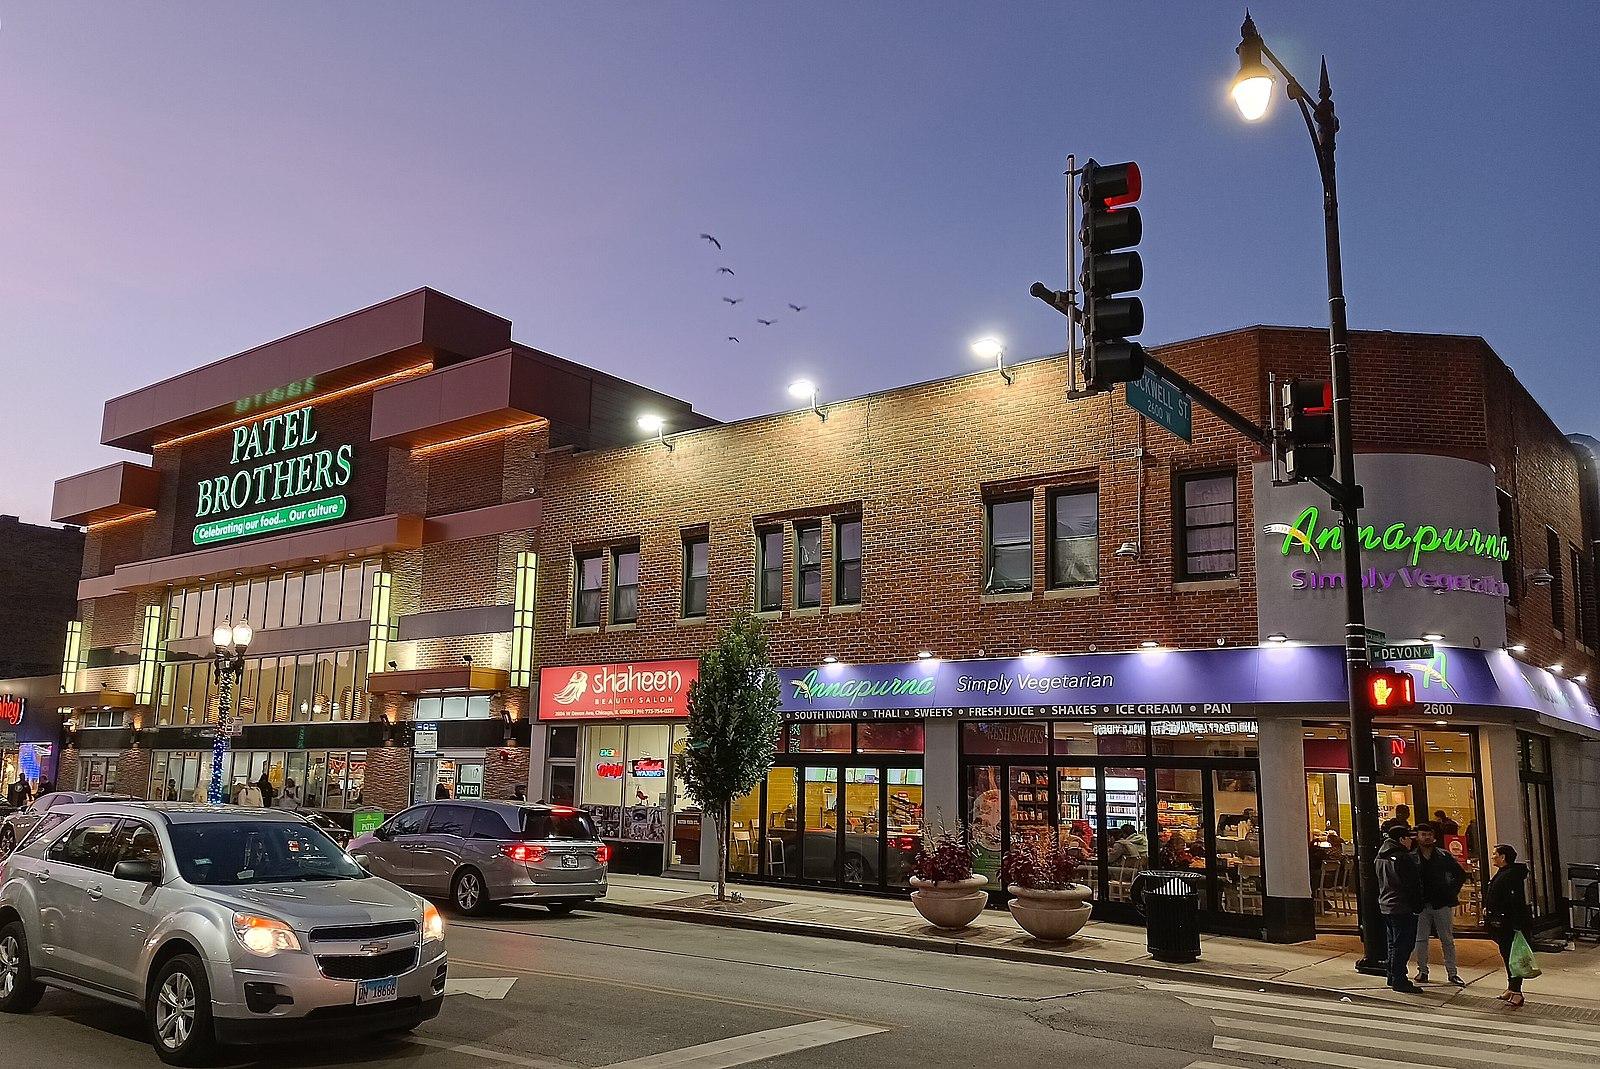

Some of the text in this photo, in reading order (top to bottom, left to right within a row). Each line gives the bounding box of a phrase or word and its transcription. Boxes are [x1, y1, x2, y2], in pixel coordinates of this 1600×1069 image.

[1131, 374, 1174, 410] CKWELL
[230, 406, 318, 465] PATEL
[195, 444, 353, 518] BROTHERS
[245, 519, 259, 531] our
[289, 509, 305, 522] Our
[1281, 506, 1510, 566] Annapurna
[1381, 646, 1422, 660] DEVON
[592, 665, 682, 694] shaheen
[792, 669, 936, 707] Annapurna
[957, 671, 1114, 695] Simply Vegetarian
[0, 694, 21, 725] hey
[594, 696, 673, 705] BEAUTY SALON
[794, 710, 824, 720] SOUTH
[826, 710, 858, 719] INDIAN
[872, 709, 900, 718] THALI
[914, 708, 953, 718] SWEETS
[969, 707, 1002, 716] FRESH
[1003, 706, 1034, 716] JUICE
[1051, 705, 1097, 715] SHAKES
[1115, 704, 1136, 715] ICE
[1137, 704, 1182, 715] CREAM
[1203, 703, 1231, 714] PAN
[1423, 704, 1453, 715] 2600
[1012, 727, 1045, 744] SNACKS
[456, 783, 479, 796] ENTER
